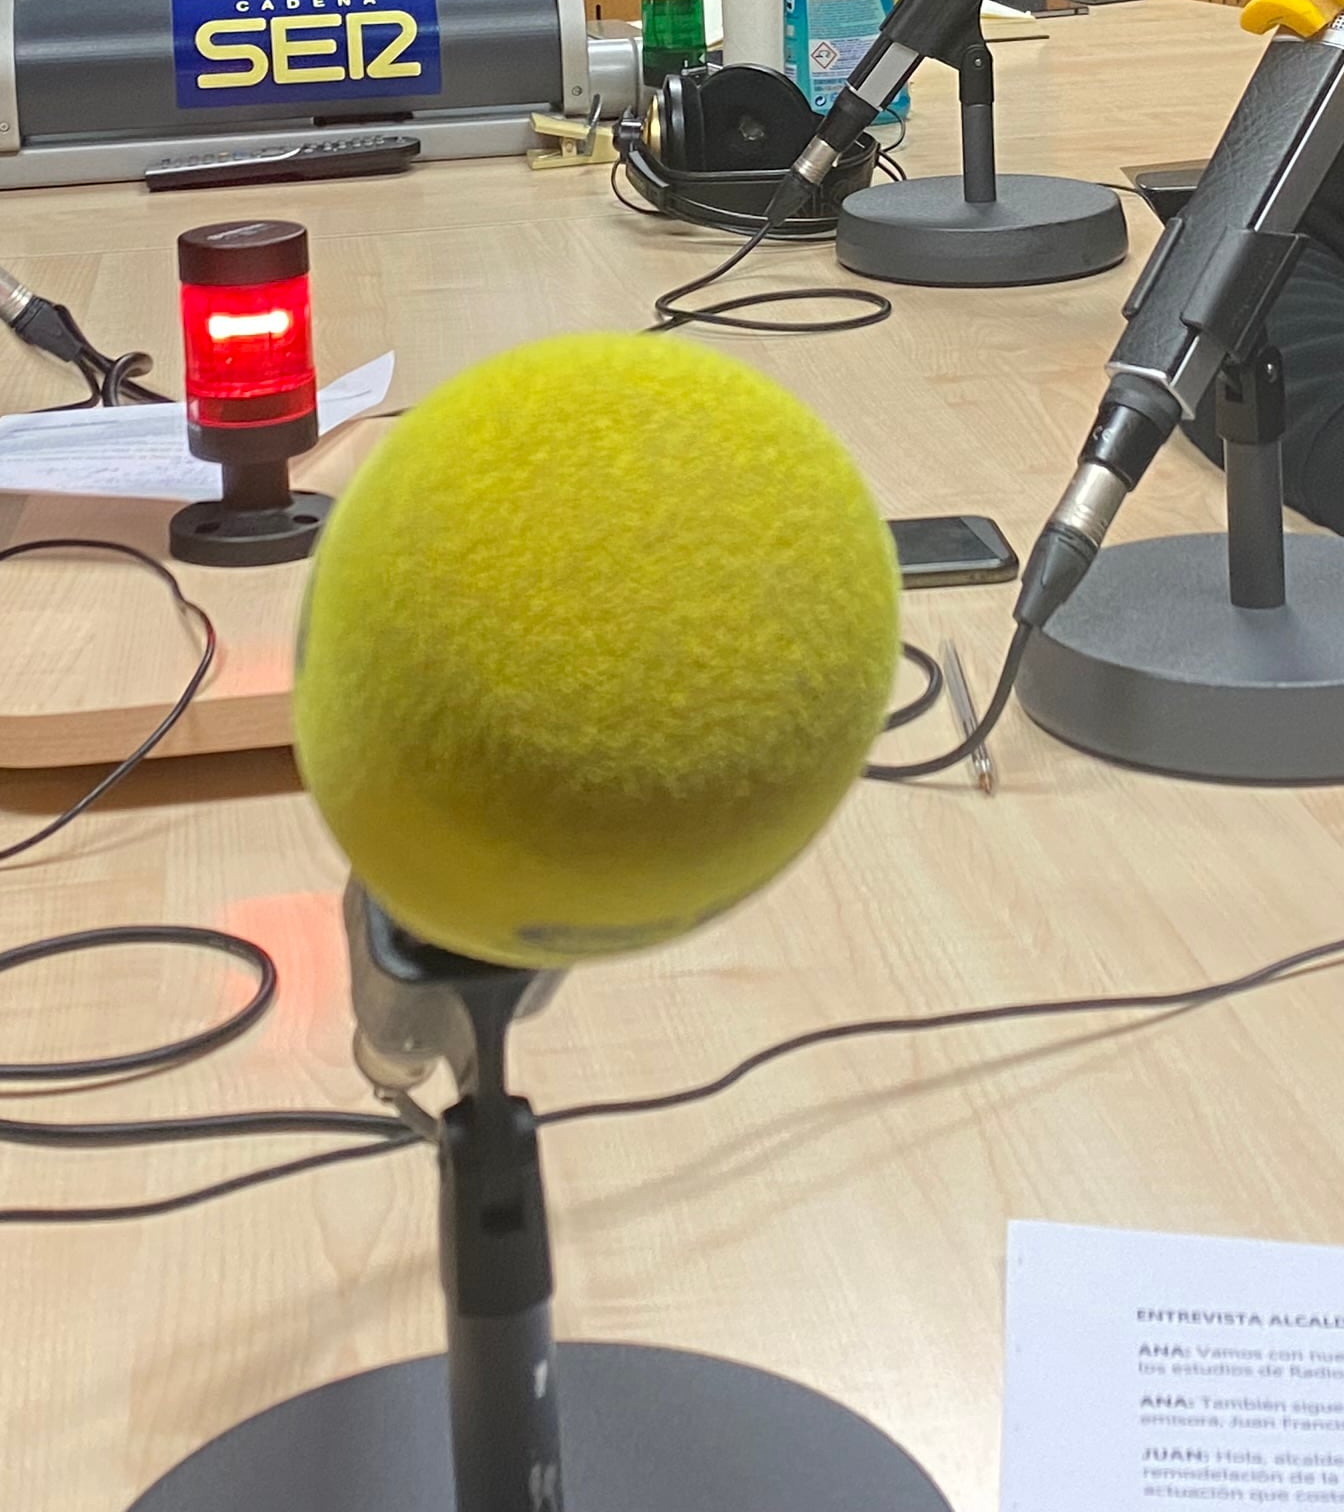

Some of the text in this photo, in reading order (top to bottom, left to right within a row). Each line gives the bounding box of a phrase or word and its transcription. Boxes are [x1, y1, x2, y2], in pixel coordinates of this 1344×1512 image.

[194, 9, 422, 90] SER
[1137, 1308, 1262, 1326] ENTREVISTA
[1139, 1343, 1191, 1358] ANA:
[1196, 1345, 1262, 1360] Vamos
[1258, 1364, 1283, 1377] de
[1290, 1365, 1344, 1379] Radio
[1140, 1394, 1194, 1409] ANA:
